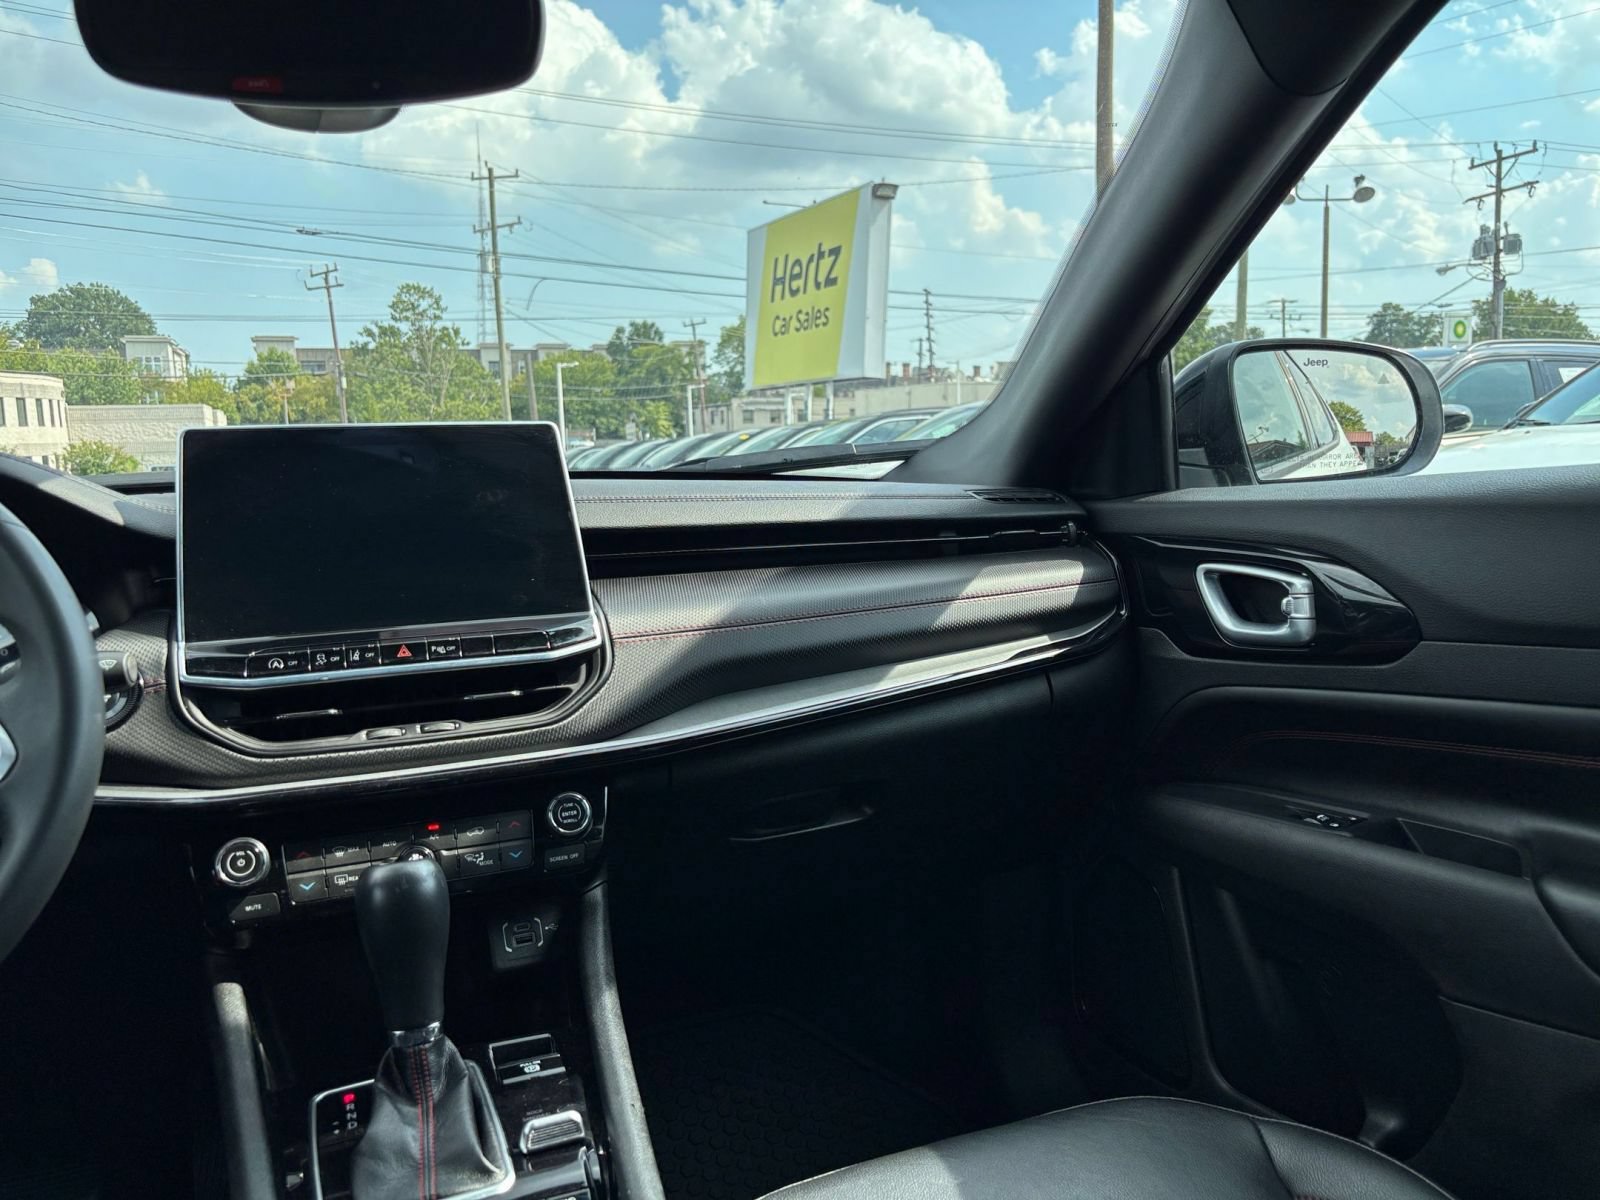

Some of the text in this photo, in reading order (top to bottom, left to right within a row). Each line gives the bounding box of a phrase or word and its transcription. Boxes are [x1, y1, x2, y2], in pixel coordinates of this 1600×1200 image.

[770, 242, 842, 303] Hertz
[772, 306, 830, 337] Car Sales
[1303, 357, 1328, 368] Jeep
[549, 854, 569, 863] SCREEN
[244, 903, 262, 912] MUTE
[346, 1111, 357, 1120] N
